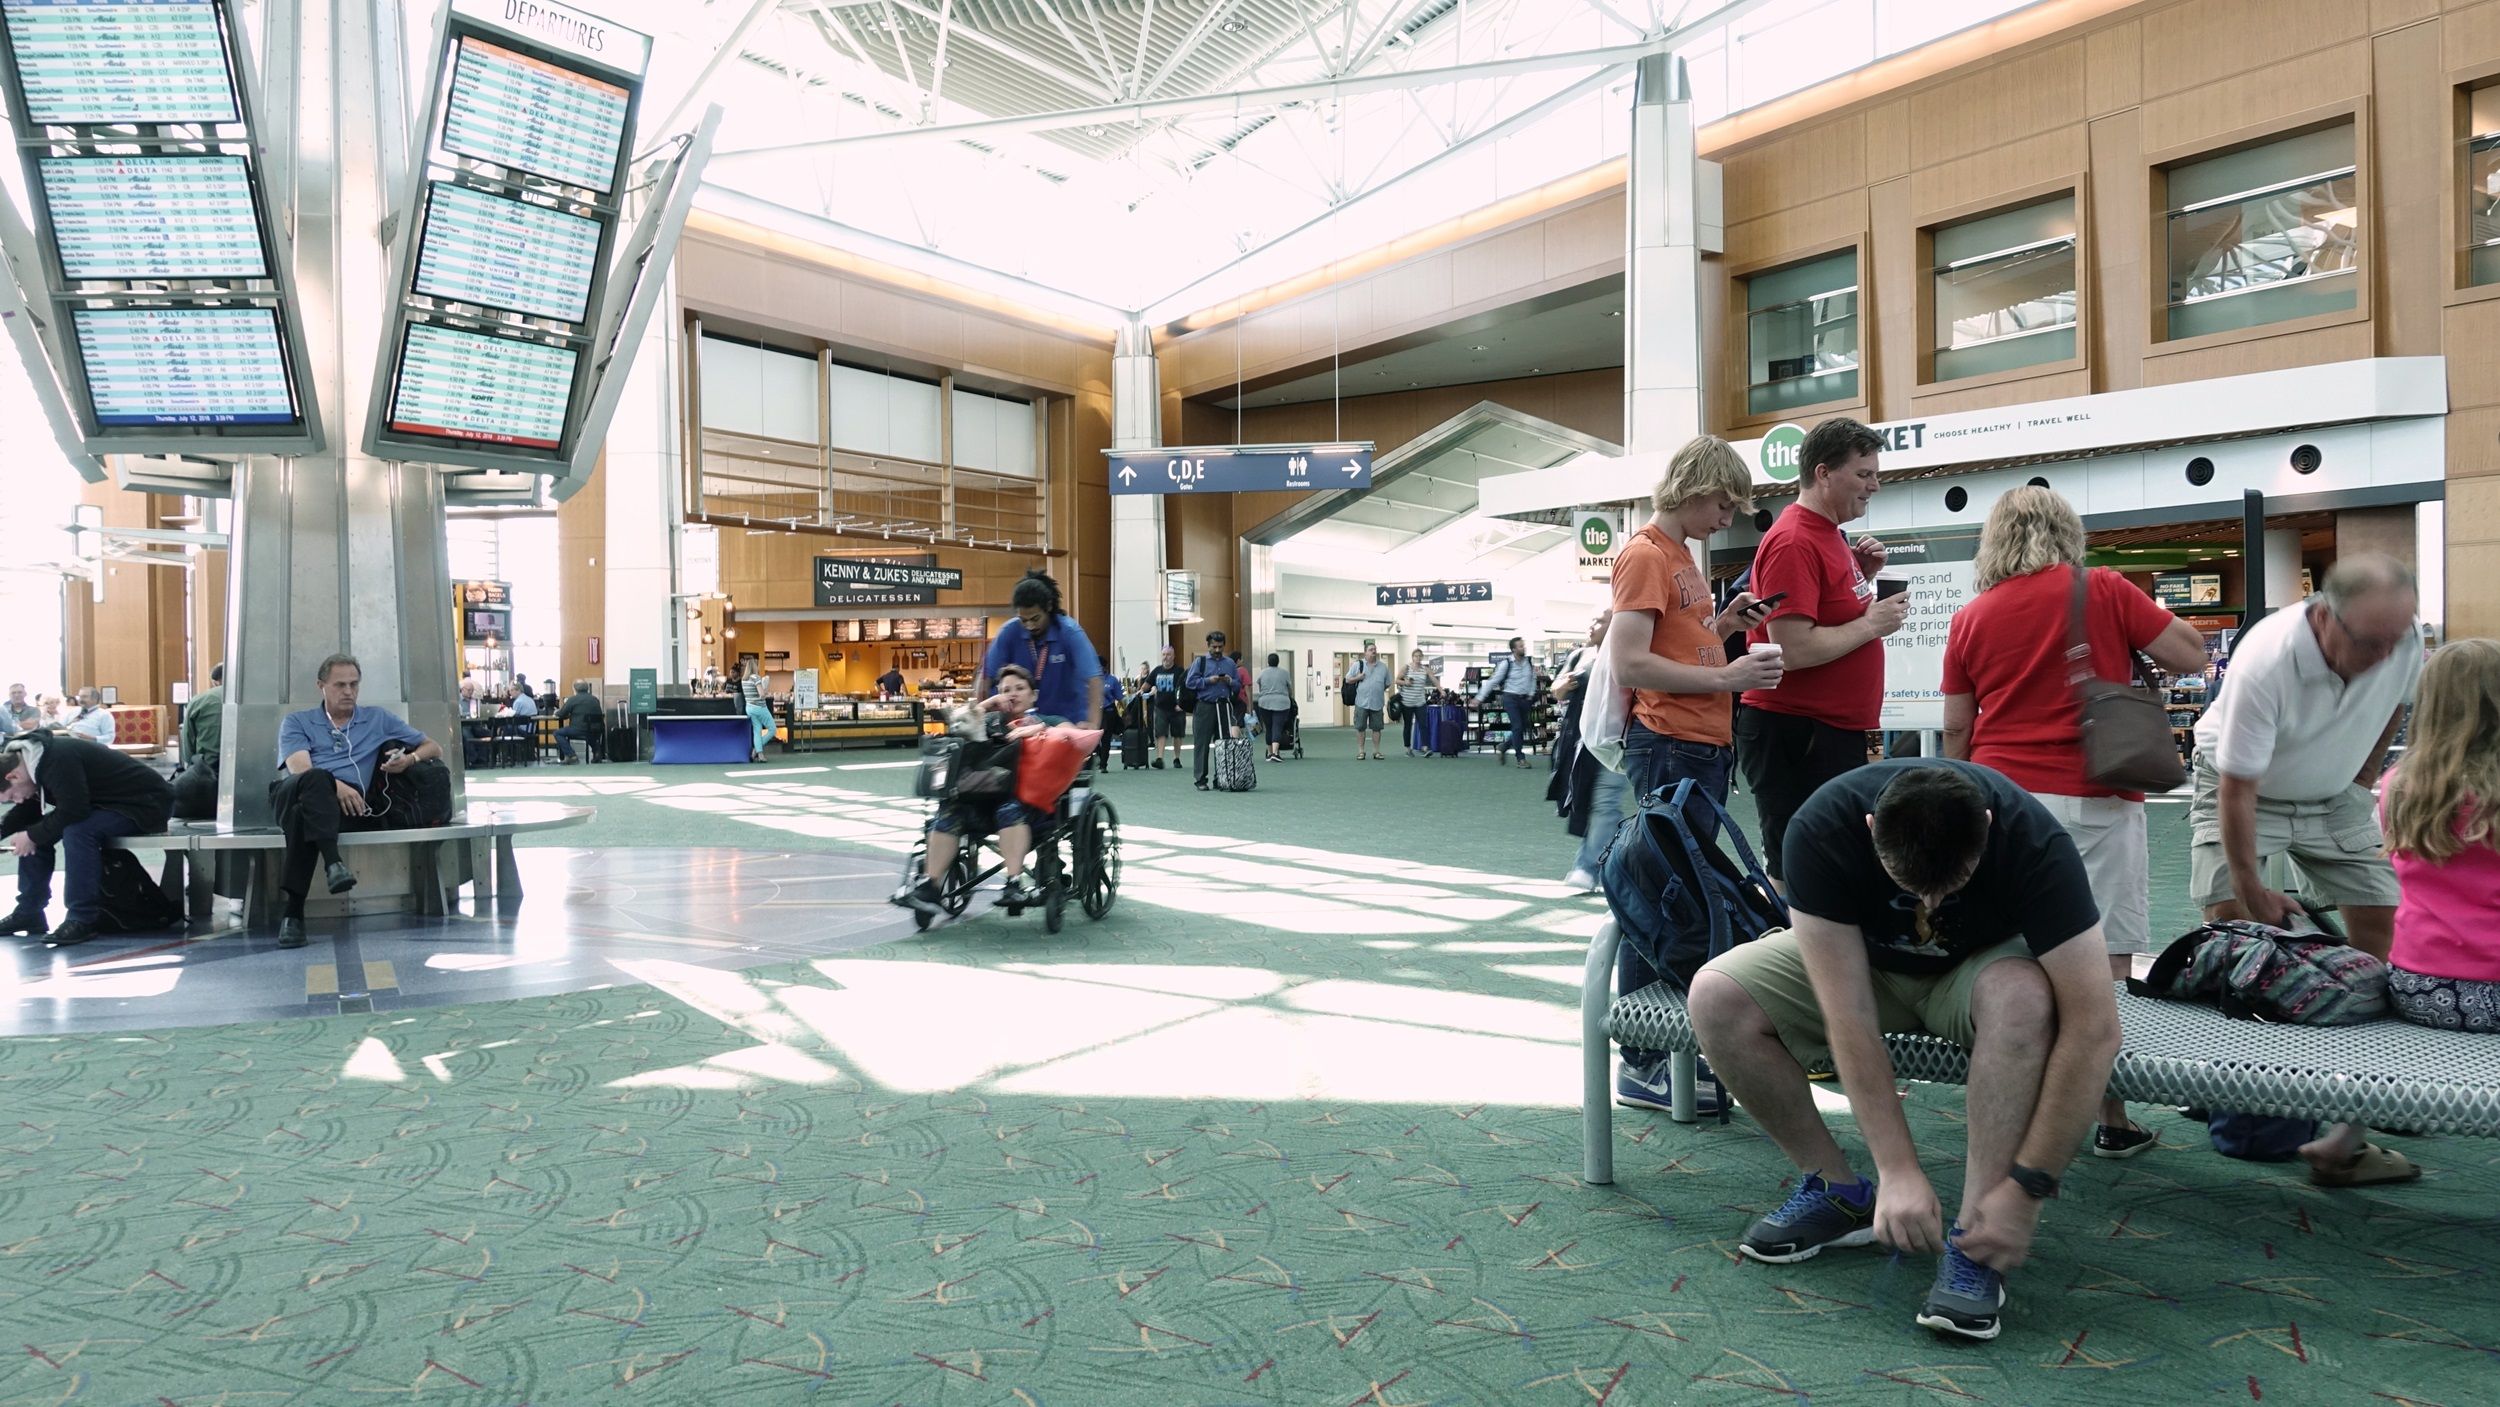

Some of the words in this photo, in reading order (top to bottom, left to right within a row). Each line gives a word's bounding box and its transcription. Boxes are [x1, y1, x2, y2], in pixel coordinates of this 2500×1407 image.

[505, 0, 605, 52] DEPARTURES
[2027, 417, 2062, 428] TRAVEL
[2066, 412, 2092, 422] WELL
[1934, 430, 1968, 439] CHOOSE
[1971, 423, 2011, 435] HEALTHY
[1880, 423, 1927, 452] KET
[1766, 439, 1799, 468] the
[1168, 459, 1204, 484] C,D,E
[1585, 528, 1608, 545] the
[1886, 543, 1925, 554] creening
[1580, 558, 1614, 566] MARKET
[824, 563, 860, 580] KENNY
[862, 566, 870, 580] &
[874, 568, 908, 582] ZUKE'S
[911, 570, 959, 580] DELICATESSEN
[1929, 572, 1951, 584] and
[830, 594, 921, 603] DELICATESSEN
[1397, 588, 1402, 598] C
[1916, 588, 1942, 601] may
[1946, 587, 1962, 599] be
[1921, 603, 1966, 615] additio
[1920, 620, 1950, 631] prior
[1883, 635, 1913, 647] rding
[1892, 689, 1920, 699] safety
[1922, 689, 1930, 697] is
